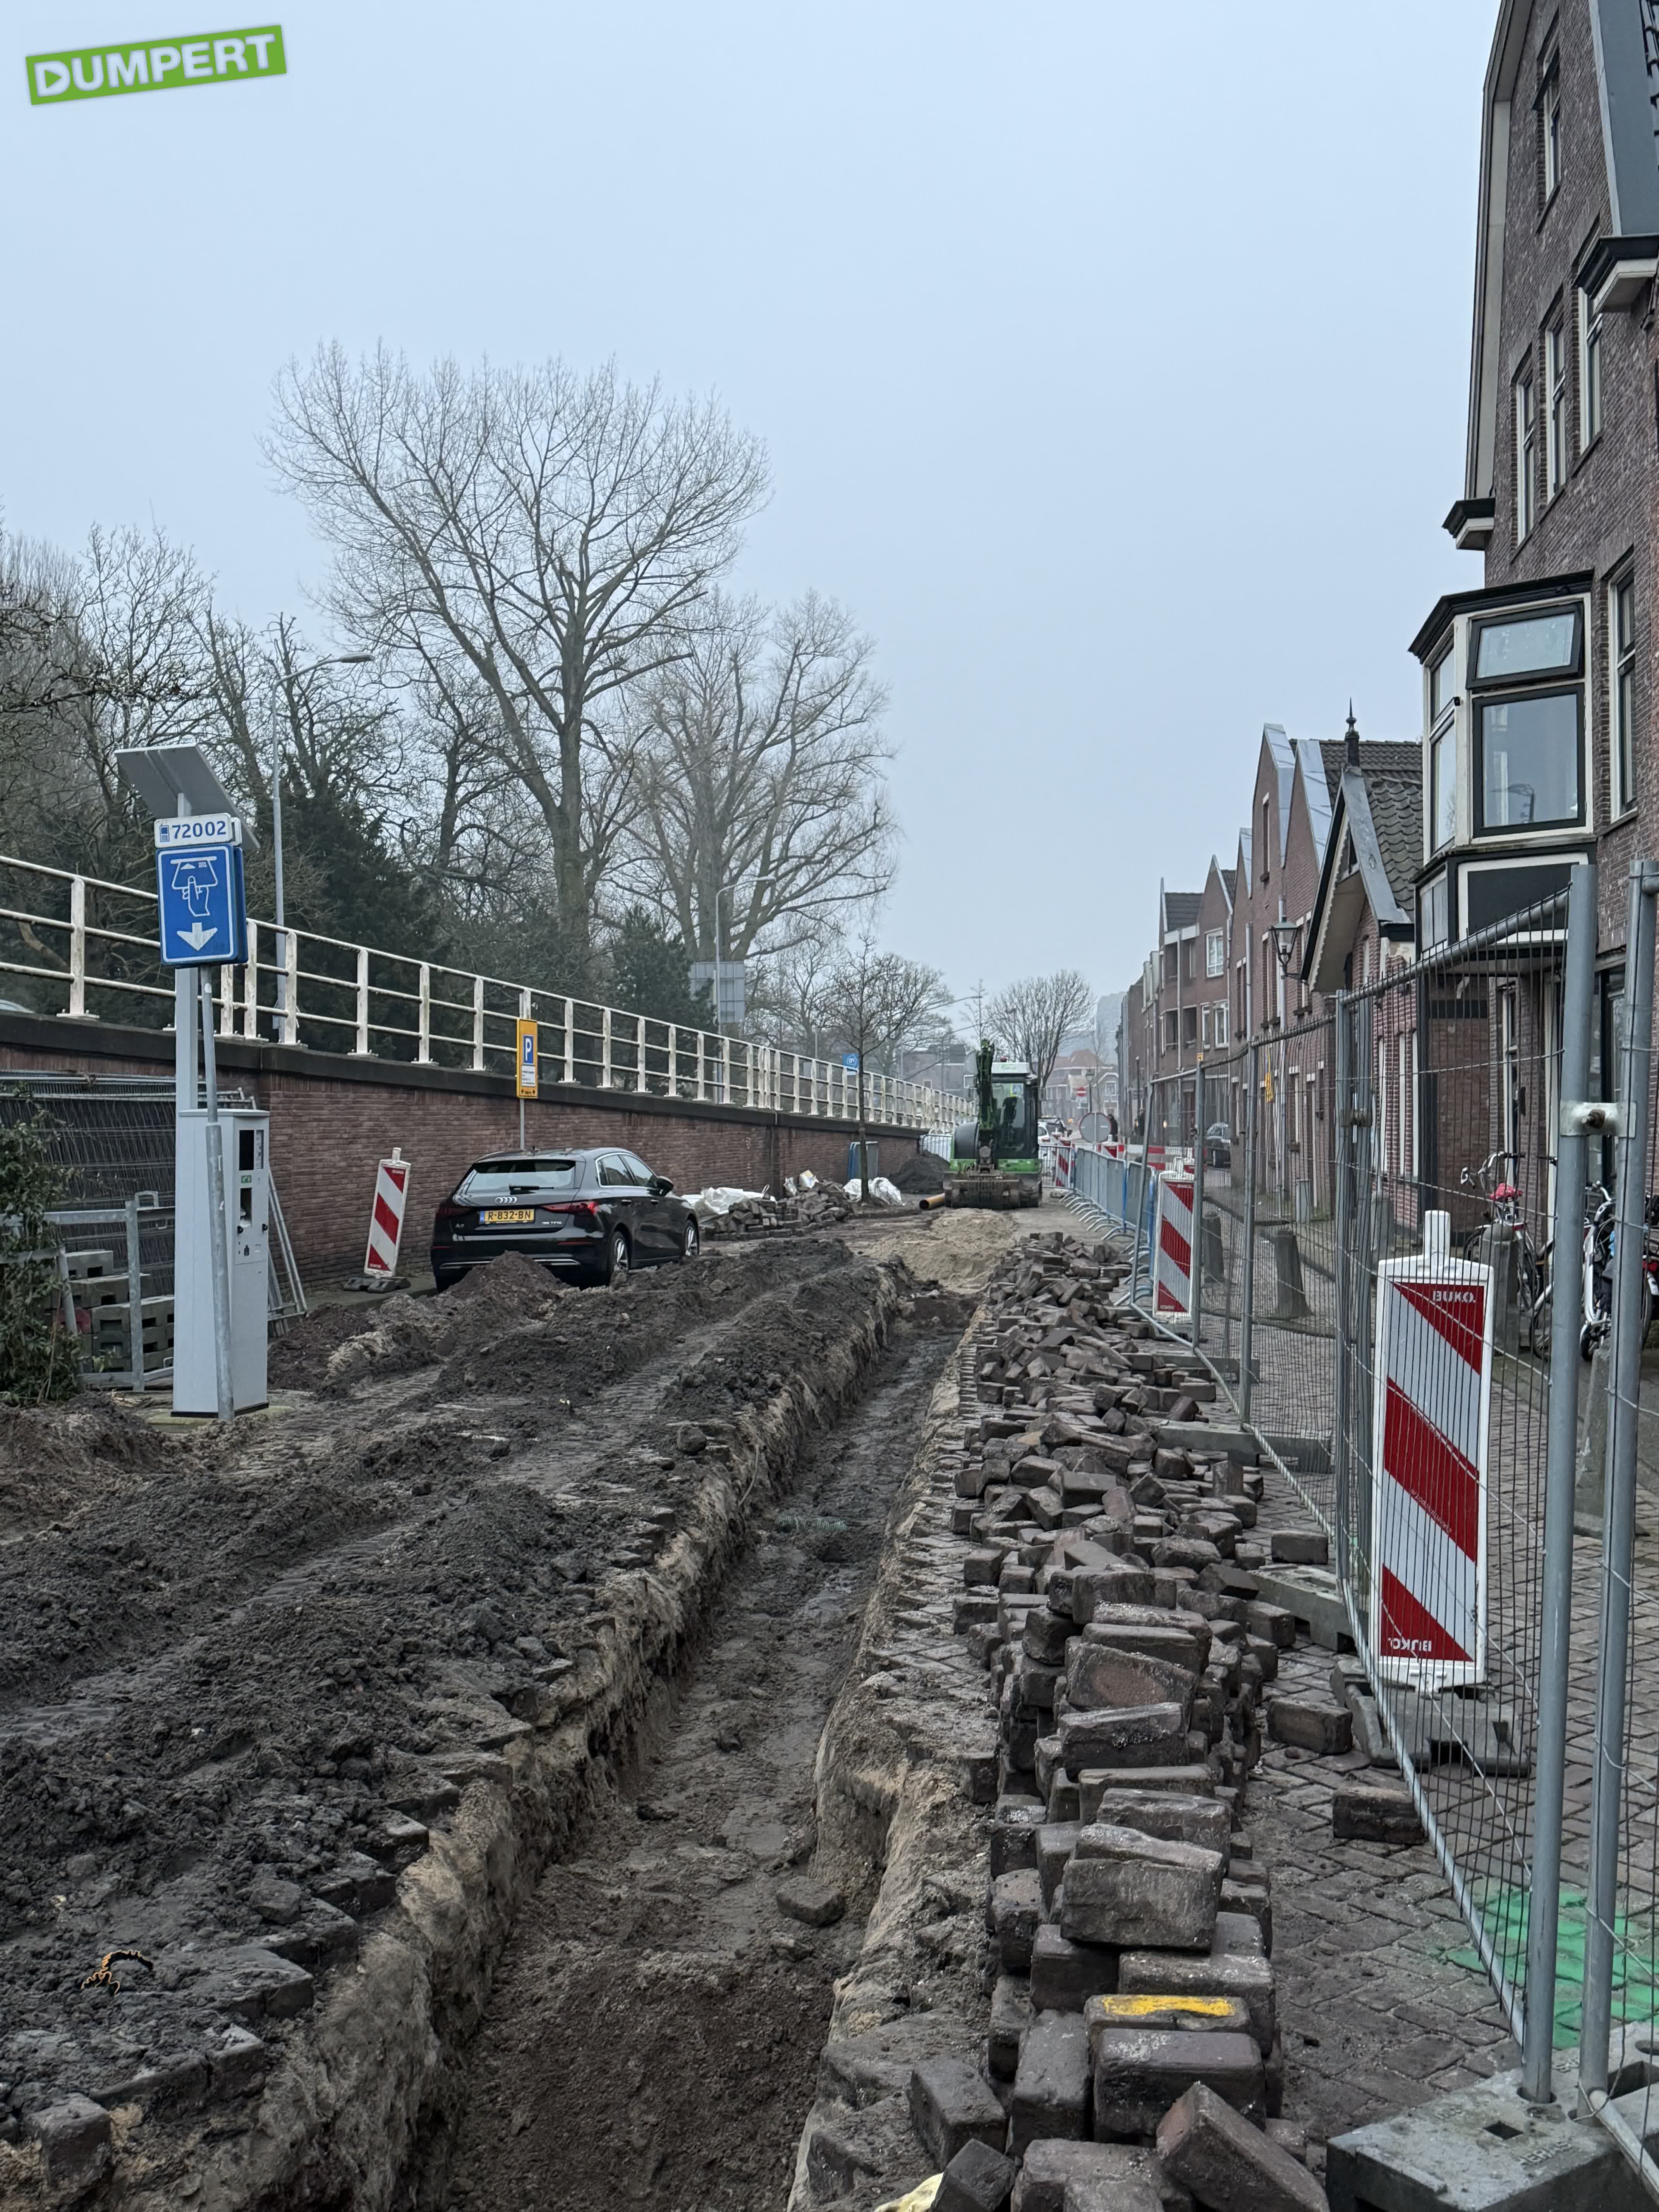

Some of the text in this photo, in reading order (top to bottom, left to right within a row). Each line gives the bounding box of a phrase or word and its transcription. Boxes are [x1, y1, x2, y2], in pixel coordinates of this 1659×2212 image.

[172, 821, 226, 839] 72002
[525, 1037, 532, 1061] P
[488, 1210, 531, 1220] R-832-BN
